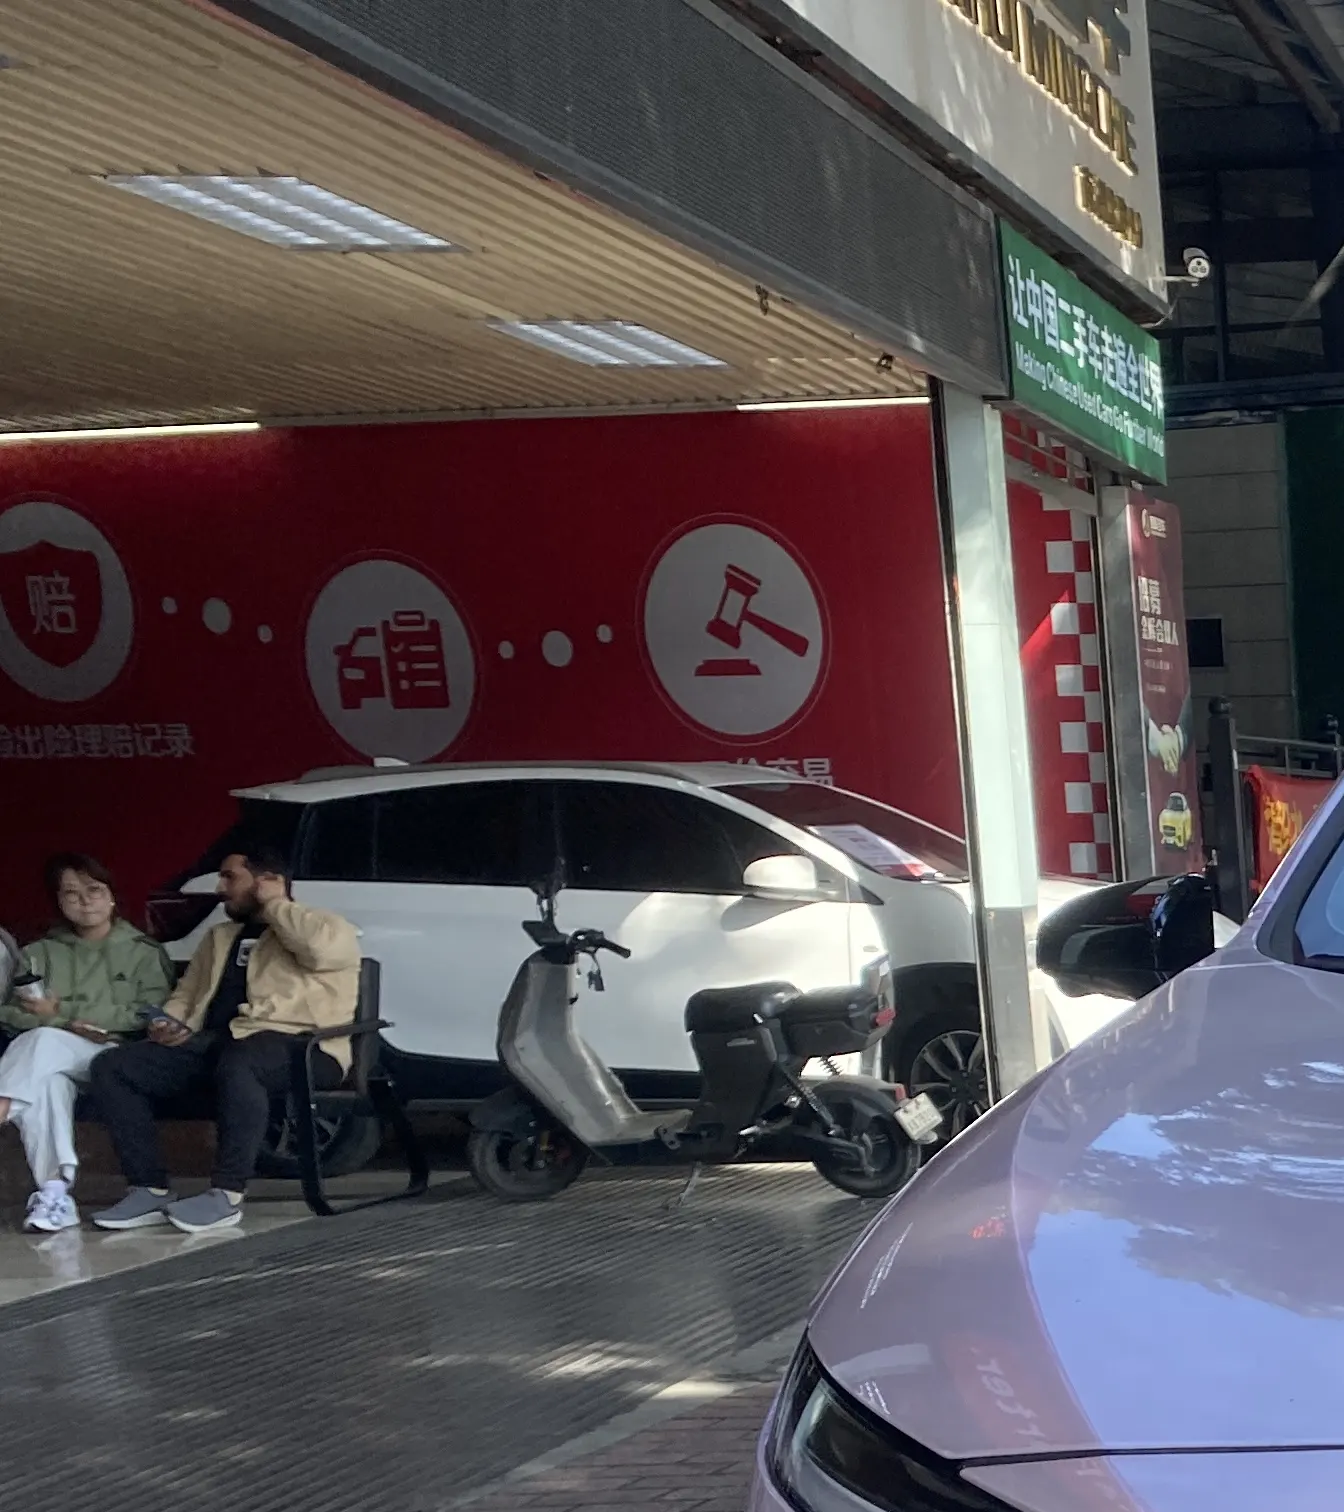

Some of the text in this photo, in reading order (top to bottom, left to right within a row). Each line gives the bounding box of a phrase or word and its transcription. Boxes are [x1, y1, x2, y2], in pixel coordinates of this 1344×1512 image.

[1008, 254, 1164, 420] 让中国二手车走遍全世界
[1015, 341, 1047, 391] Making
[1046, 361, 1078, 405] Chinese
[25, 569, 78, 635] 赔
